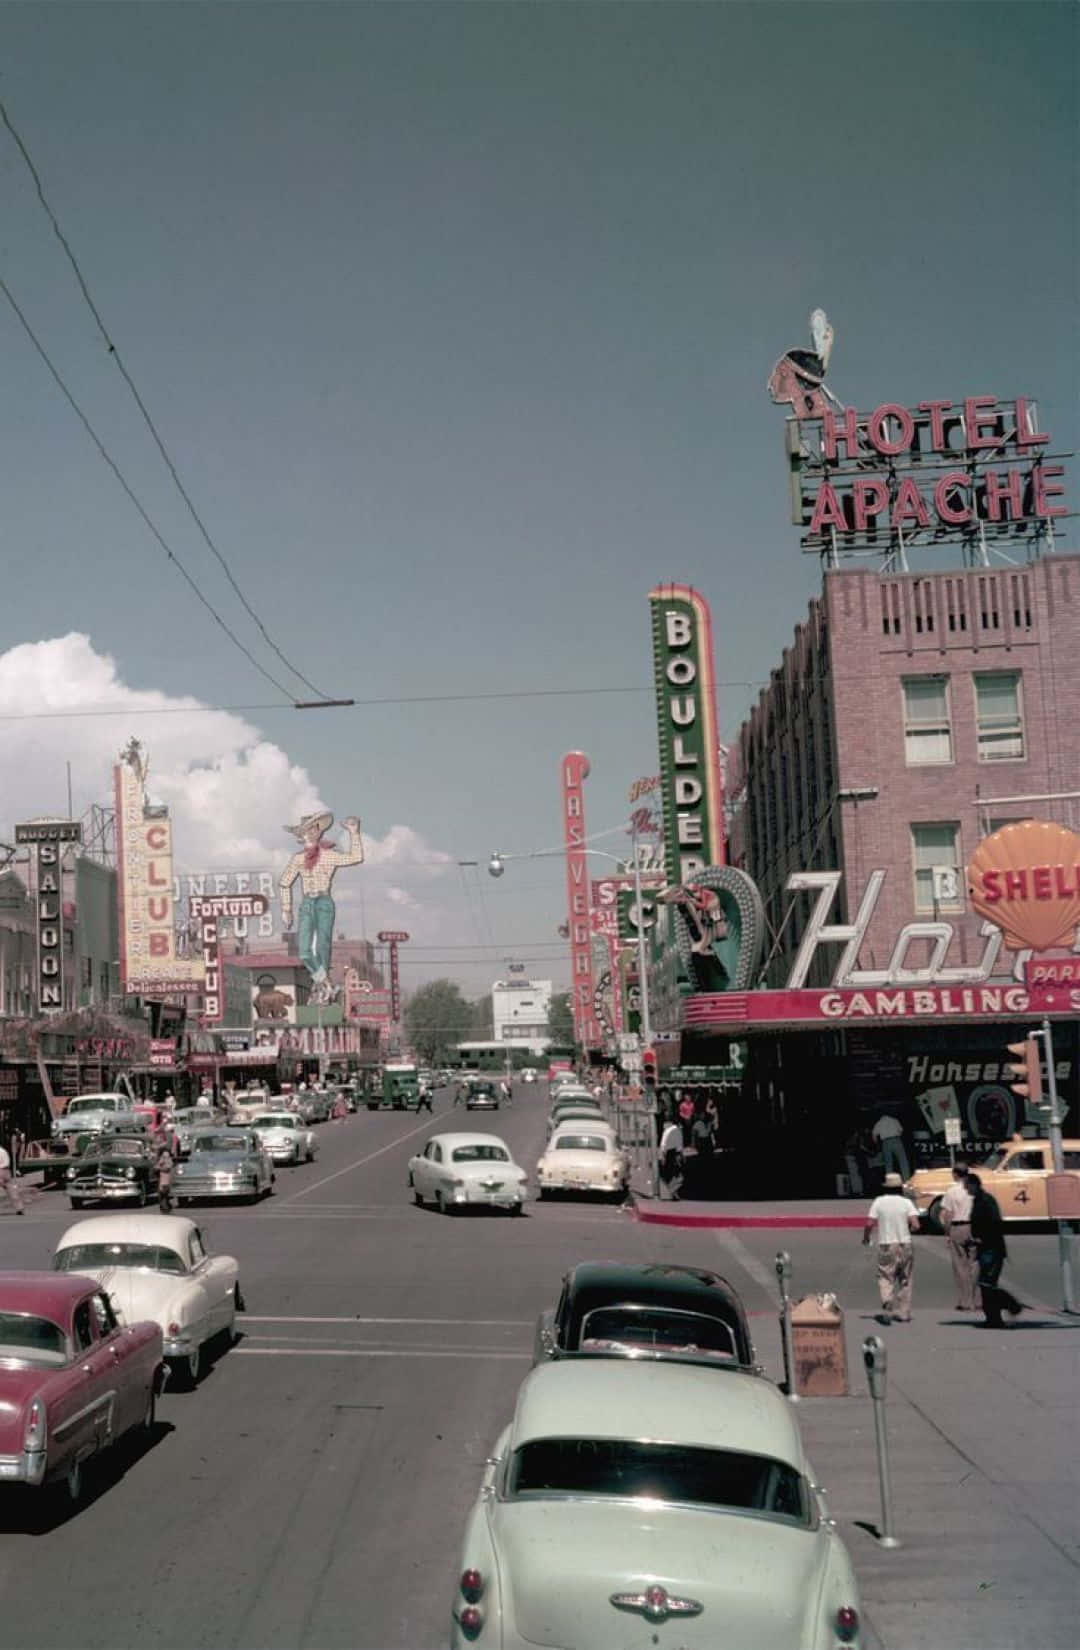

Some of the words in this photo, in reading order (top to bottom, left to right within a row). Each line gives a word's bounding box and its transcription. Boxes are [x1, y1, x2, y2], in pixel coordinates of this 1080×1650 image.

[822, 396, 1050, 460] HOTEL
[810, 466, 1069, 533] APACHE
[566, 767, 582, 846] LAS
[40, 845, 60, 1005] SALOON
[146, 826, 171, 957] CLUB
[190, 896, 264, 917] Fortune
[204, 924, 219, 1016] CLUB
[571, 864, 592, 1006] VEGAS
[819, 988, 1030, 1017] GAMBLING
[1014, 1189, 1030, 1205] 4
